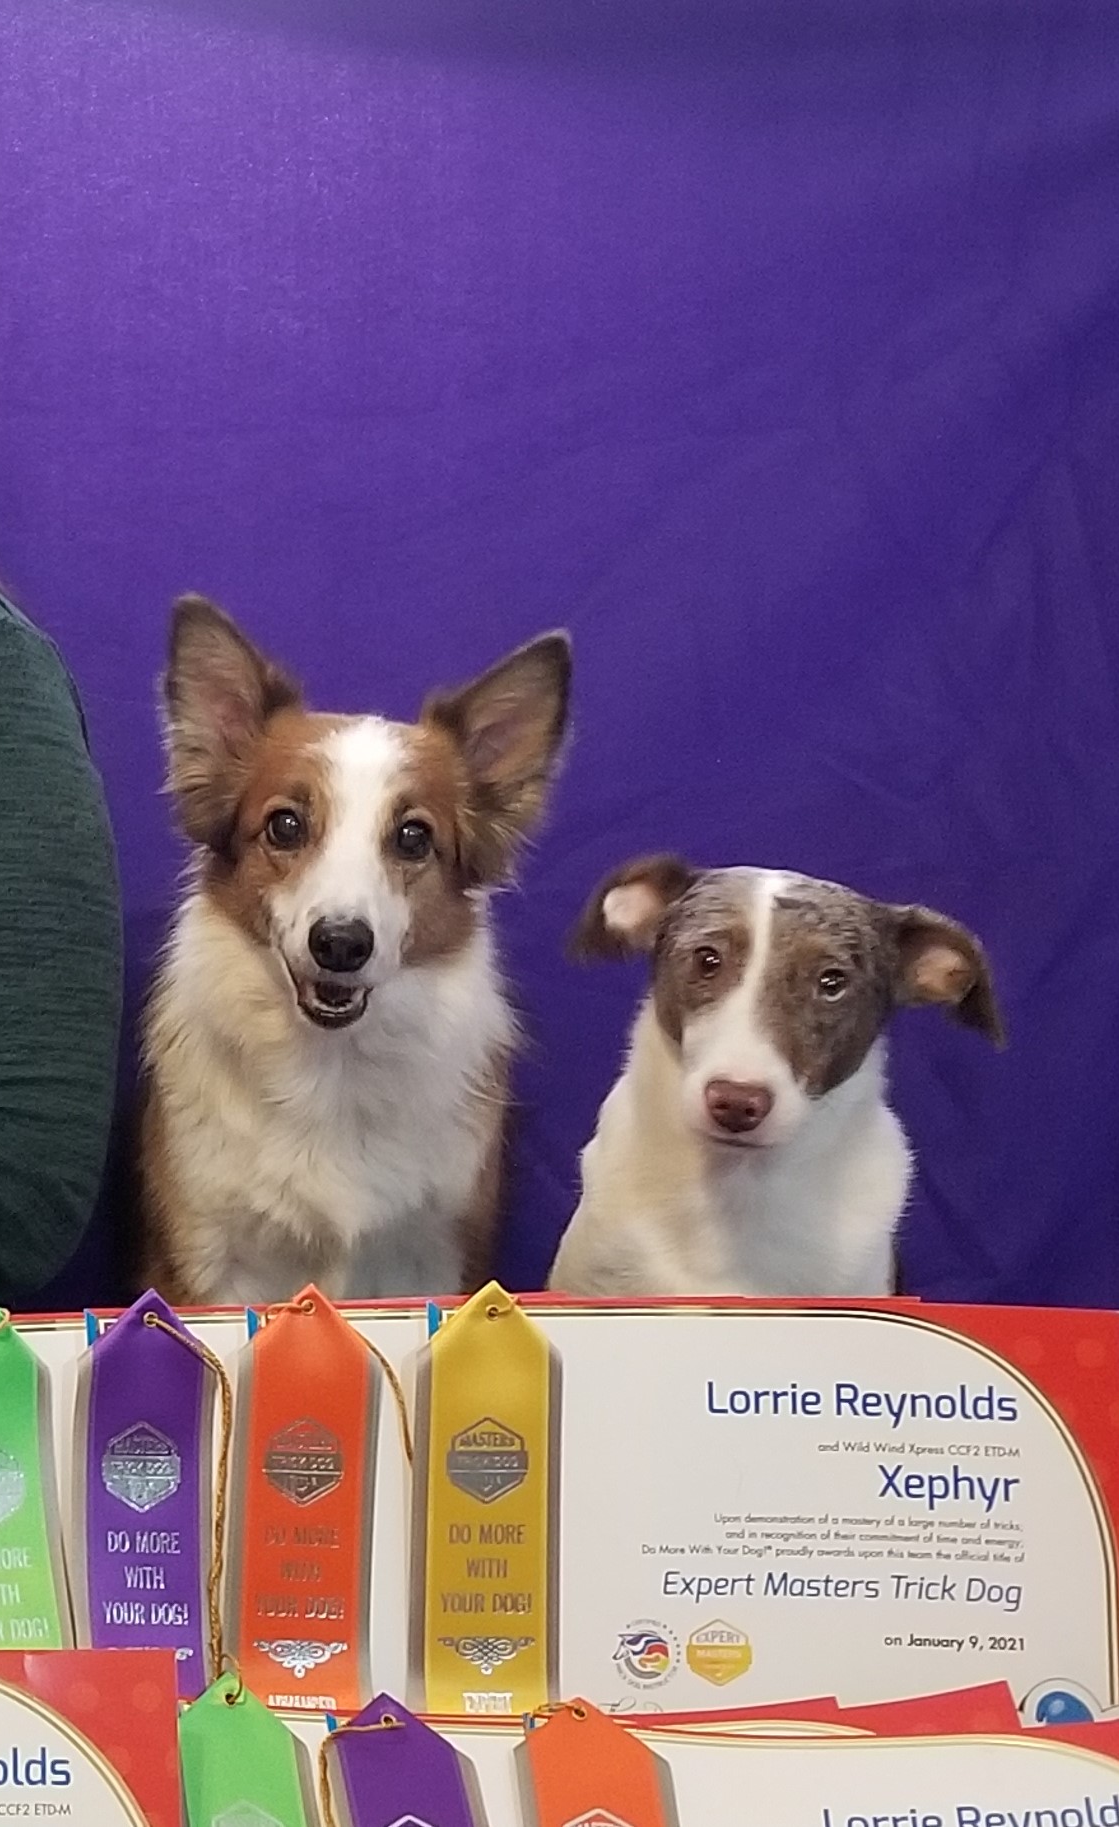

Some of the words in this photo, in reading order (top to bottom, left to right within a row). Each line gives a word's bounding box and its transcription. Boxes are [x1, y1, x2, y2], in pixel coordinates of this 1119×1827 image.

[707, 1381, 822, 1416] Lorrie
[835, 1382, 1019, 1428] Reynolds
[818, 1441, 839, 1452] and
[843, 1441, 870, 1453] Wild
[874, 1442, 905, 1454] Wind
[908, 1443, 945, 1457] Xpress
[948, 1444, 980, 1456] CCF2
[878, 1464, 1020, 1512] Xephyr
[714, 1513, 741, 1525] Upon
[818, 1514, 828, 1524] of
[884, 1515, 894, 1526] of
[908, 1516, 935, 1529] large
[938, 1518, 976, 1529] number
[980, 1519, 990, 1529] of
[107, 1531, 130, 1553] DO
[136, 1531, 181, 1554] MORE
[449, 1524, 472, 1544] DO
[479, 1524, 526, 1544] MORE
[726, 1529, 745, 1539] and
[749, 1530, 757, 1539] in
[761, 1530, 817, 1542] recognition
[820, 1529, 830, 1540] of
[923, 1533, 933, 1543] of
[961, 1535, 981, 1545] and
[659, 1545, 685, 1555] More
[717, 1545, 739, 1555] Your
[775, 1546, 814, 1558] proudly
[1014, 1552, 1025, 1563] of
[124, 1566, 165, 1589] WITH
[466, 1557, 507, 1578] WITH
[663, 1571, 755, 1603] Expert
[763, 1572, 879, 1600] Masters
[890, 1574, 956, 1602] Trick
[966, 1576, 1023, 1612] Dog
[103, 1602, 145, 1625] YOUR
[151, 1603, 189, 1625] DOG!
[441, 1592, 485, 1613] YOUR
[492, 1592, 532, 1615] DOG!
[10, 1617, 49, 1640] DOG!
[884, 1636, 902, 1646] on
[907, 1633, 965, 1652] January
[968, 1635, 983, 1651] 9,
[988, 1636, 1025, 1651] 2021
[34, 1804, 72, 1816] ETD-M
